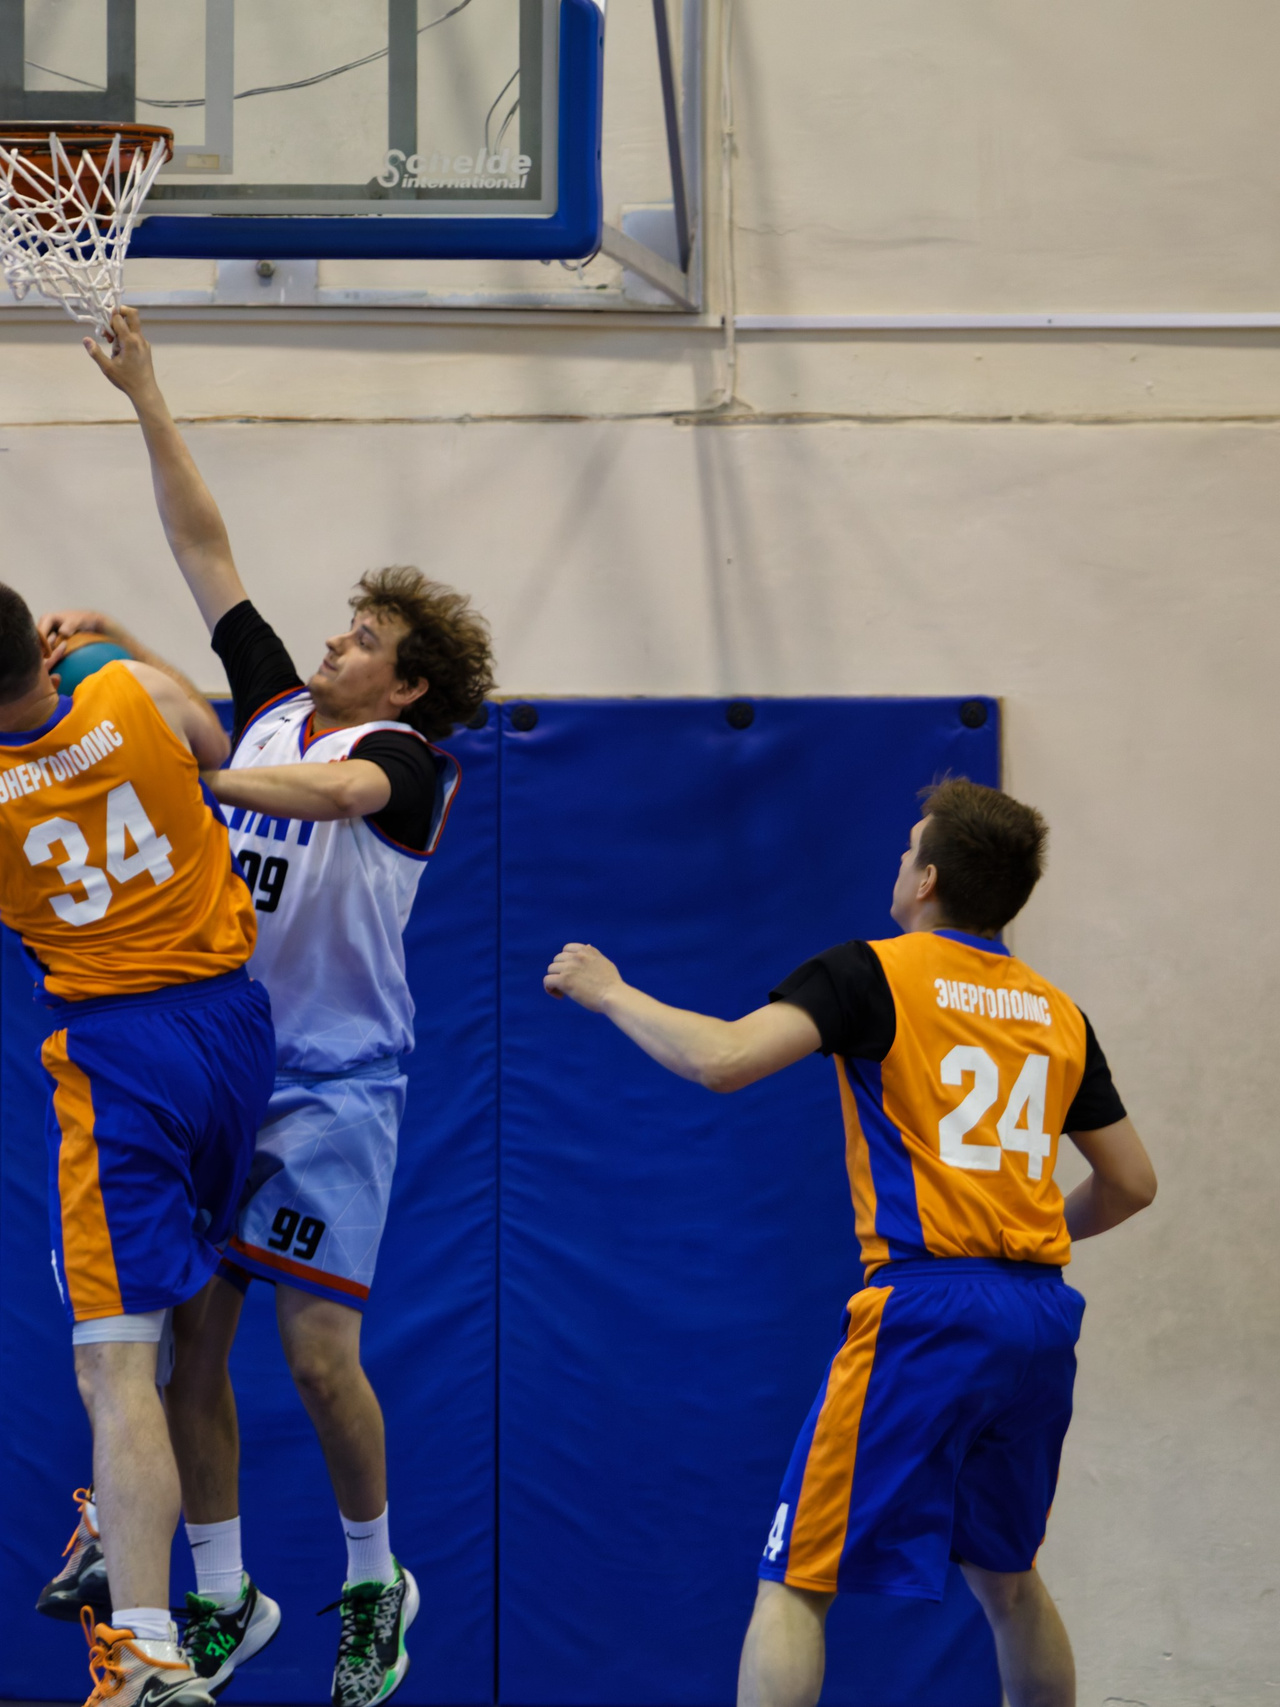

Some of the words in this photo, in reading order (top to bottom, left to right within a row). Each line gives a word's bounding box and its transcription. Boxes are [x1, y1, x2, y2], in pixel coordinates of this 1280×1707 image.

[376, 149, 532, 188] Schelde
[401, 174, 527, 189] international
[23, 781, 175, 927] 34
[934, 978, 1051, 1026] ЭНЕРГОПОЛИС
[938, 1044, 1051, 1180] 24
[267, 1206, 326, 1261] 99
[763, 1502, 789, 1562] 4
